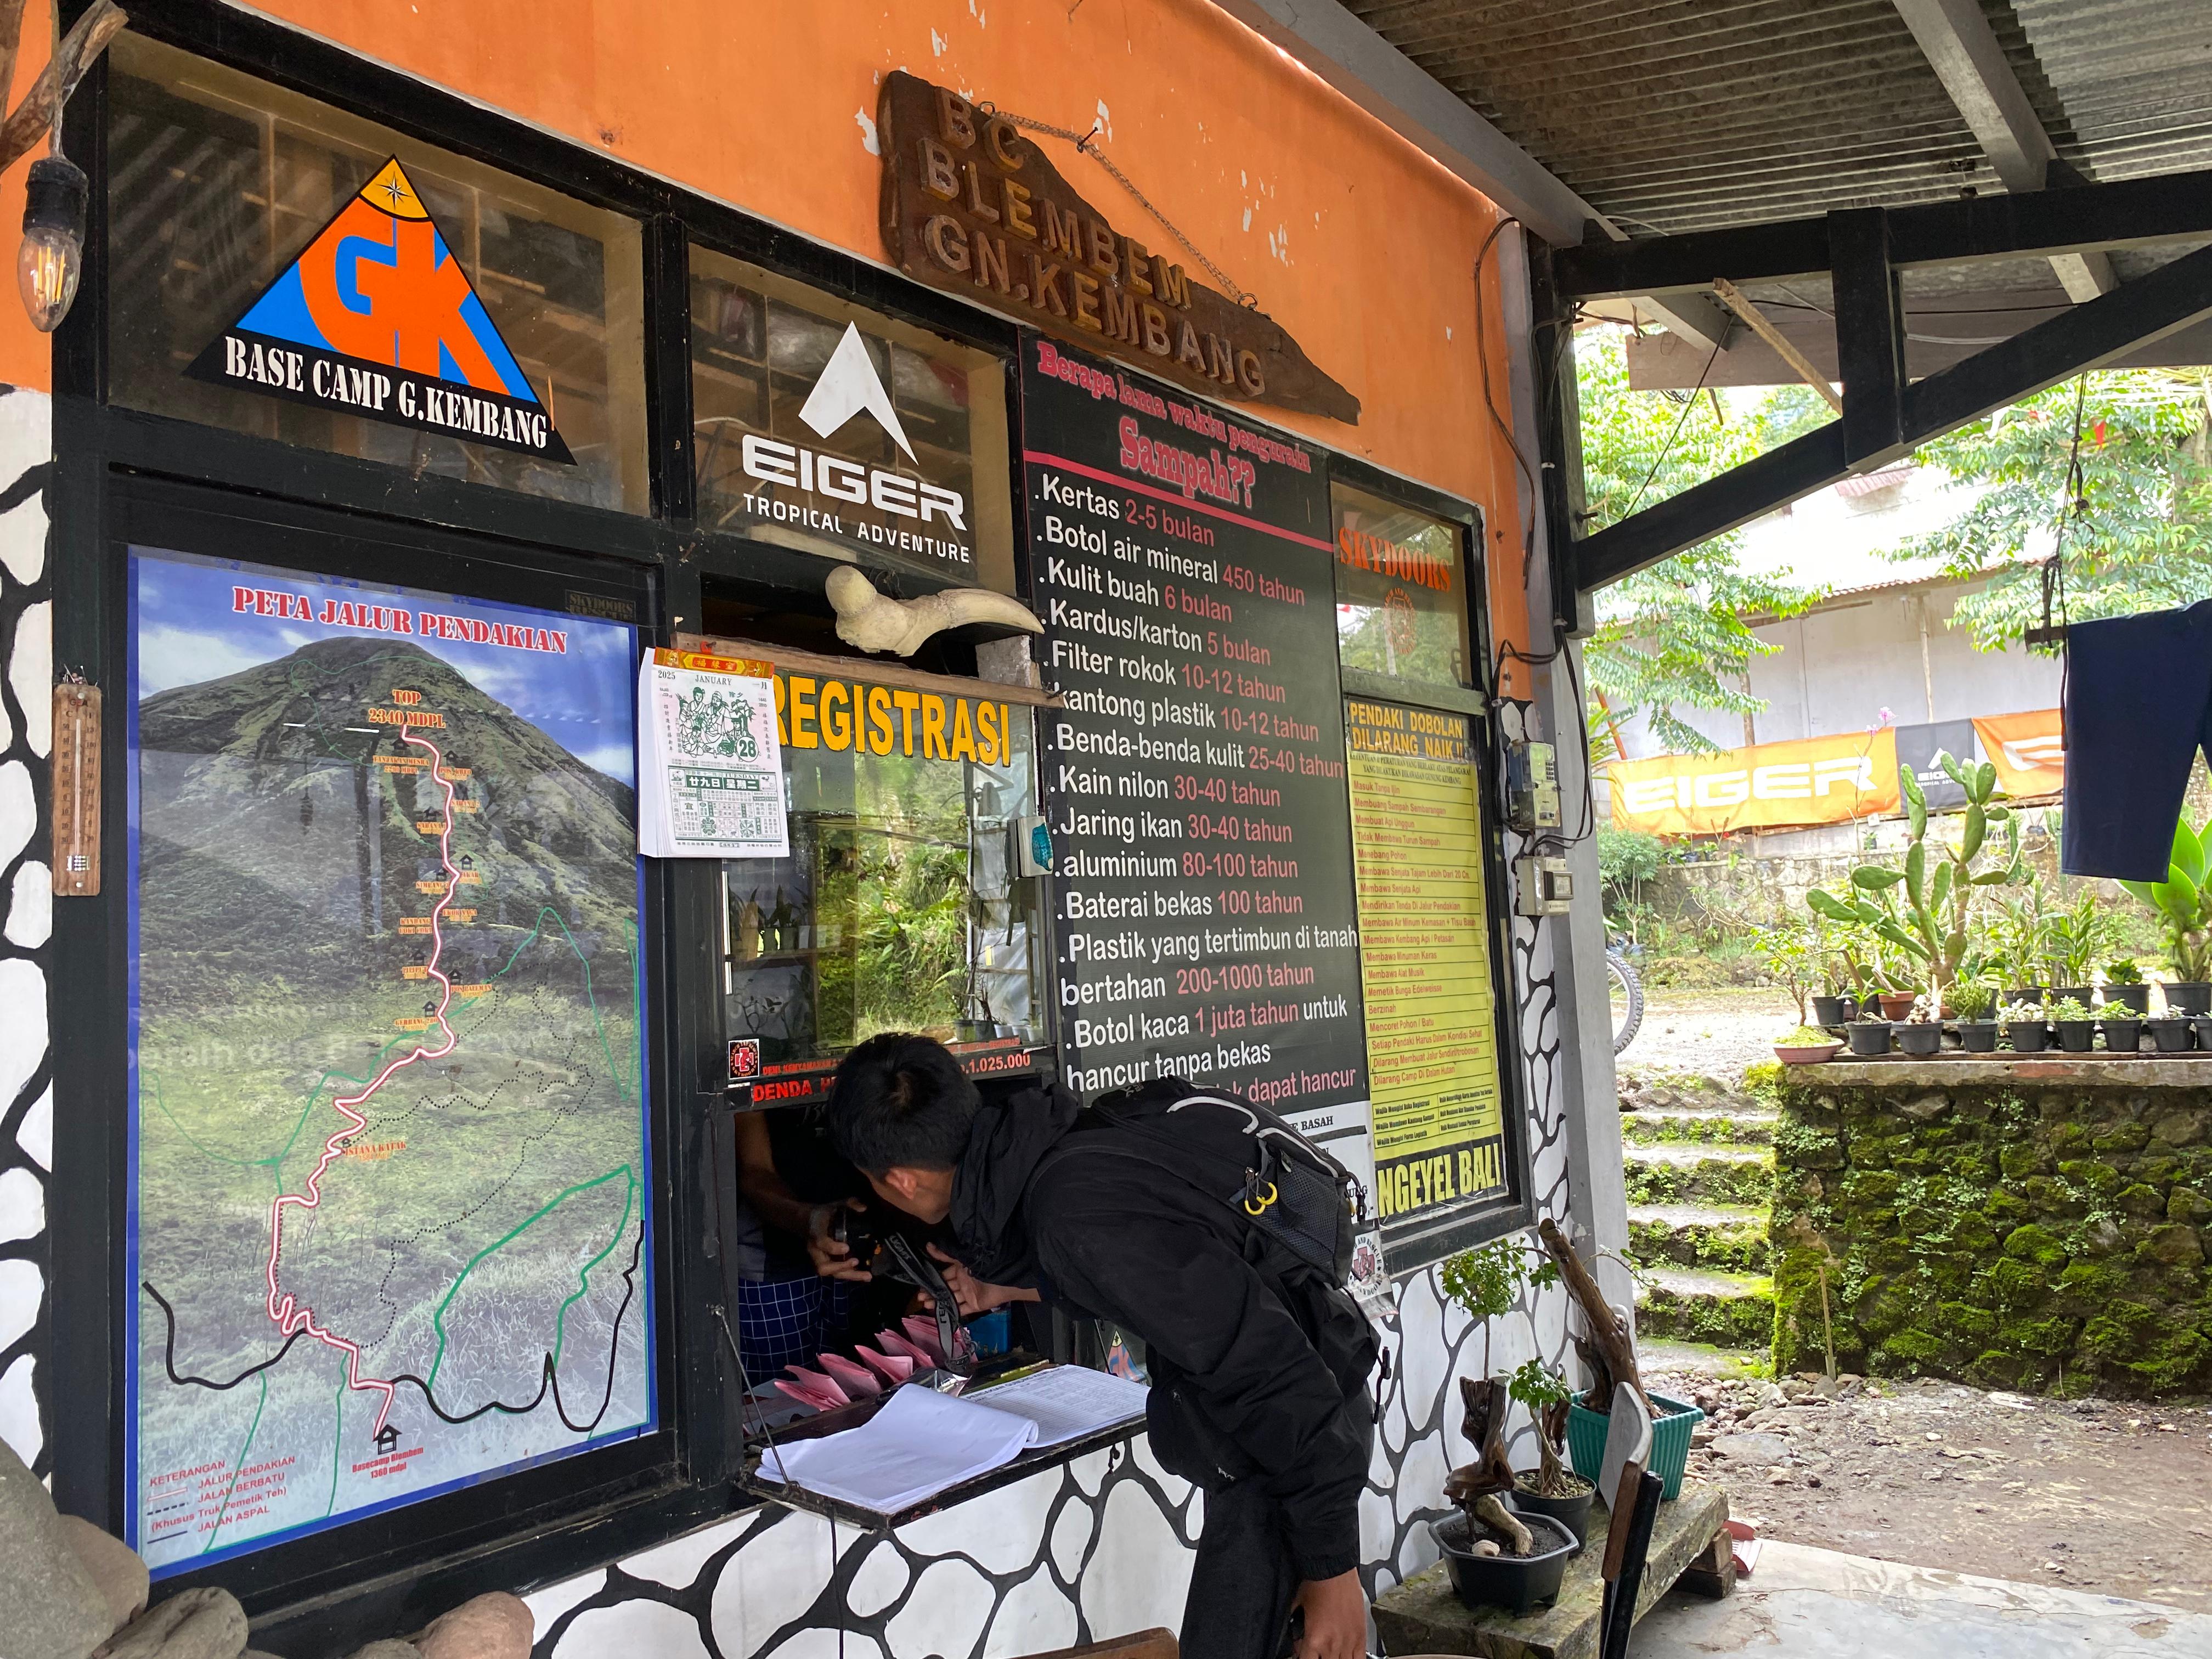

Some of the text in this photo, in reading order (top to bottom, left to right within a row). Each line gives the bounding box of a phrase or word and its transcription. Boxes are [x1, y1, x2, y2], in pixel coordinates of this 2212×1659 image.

[917, 137, 1192, 310] BLEMBEM
[924, 215, 1265, 397] GN.KEMBANG
[225, 336, 546, 449] BASE CAMP G.KEMBANG
[1037, 341, 1311, 473] Berapa lama waktu pengurain
[1120, 416, 1255, 509] Sampah??
[742, 435, 967, 531] EIGER
[743, 493, 970, 563] TROPICAL ADVENTURE
[1126, 499, 1156, 530] 2-5
[1163, 509, 1214, 546] bulan
[1114, 537, 1142, 563] air
[1147, 550, 1217, 584] mineral
[1223, 565, 1254, 592] 450
[1259, 573, 1305, 605] tahun
[1339, 527, 1451, 592] SKYDOORS
[1108, 569, 1159, 606] buah
[1165, 585, 1175, 610] 6
[1182, 588, 1232, 623] bulan
[232, 586, 312, 621] PETA
[321, 600, 411, 635] JALUR
[419, 612, 567, 654] PENDAKIAN
[1207, 631, 1217, 655] 5
[1223, 635, 1271, 666] bulan
[658, 670, 732, 686] 2025 JANUARY
[1119, 655, 1176, 685] rokok
[1182, 664, 1233, 695] 10-12
[1238, 677, 1285, 703] tahun
[393, 689, 421, 706] TOP
[369, 708, 446, 729] 2340 MDPL
[1153, 697, 1216, 728] plastik
[1221, 707, 1269, 736] 10-12
[1273, 716, 1319, 742] tahun
[1350, 702, 1463, 739] PENDAKI DOBOLAN
[739, 741, 756, 757] 28
[1206, 740, 1245, 768] kulit
[1249, 746, 1294, 772] 25-40
[1299, 753, 1343, 778] tahun
[1352, 727, 1418, 755] DILARANG
[1425, 737, 1453, 759] NAIK
[689, 777, 757, 789] 廿九日 星期二
[1119, 771, 1168, 799] nilon
[1175, 775, 1226, 803] 30-40
[1232, 782, 1280, 806] tahun
[1353, 780, 1373, 791] Masuk
[1374, 782, 1390, 795] Tanpa
[1624, 755, 1878, 814] EIGER
[1355, 798, 1387, 811] Membuang
[1387, 802, 1409, 812] Sampah
[1141, 811, 1182, 838] ikan
[1188, 815, 1239, 840] 30-40
[1244, 819, 1292, 843] tahun
[1356, 815, 1414, 829] Membuat Api Unggun
[1357, 832, 1440, 847] Tidak Membawa Turun Sampah
[1358, 849, 1407, 860] Menebang Pohon
[1183, 852, 1245, 877] 80-100
[1250, 854, 1298, 878] tahun
[1154, 890, 1212, 917] bekas
[1218, 890, 1250, 915] 100
[1255, 889, 1303, 913] tahun
[1361, 883, 1421, 895] Membawa Senjata Api
[1152, 935, 1199, 964] yang
[1205, 927, 1290, 953] tertimbun
[1295, 925, 1310, 949] di
[1314, 924, 1358, 949] tanah
[1367, 952, 1396, 961] Membawa
[1421, 951, 1437, 960] Keras
[1060, 963, 1314, 1006] bertahan 200-1000 tahun
[1141, 1012, 1189, 1040] kaca
[1195, 1007, 1204, 1032] 1
[1210, 1006, 1245, 1038] juta
[1251, 999, 1299, 1025] tahun
[1303, 994, 1348, 1020] untuk
[1369, 1005, 1396, 1014] Berzinah
[1370, 1020, 1398, 1032] Mencoret
[1400, 1020, 1417, 1029] Pohon
[1372, 1039, 1391, 1049] Setiap
[1393, 1037, 1414, 1047] Pendaki
[1416, 1035, 1432, 1045] Harus
[1432, 1034, 1447, 1042] Dalam
[1448, 1032, 1468, 1040] Kondisi
[763, 1065, 781, 1075] DEMI
[1068, 1041, 1272, 1093] hancur tanpa bekas
[1374, 1066, 1455, 1085] Dilarang Camp Di Dalam Hutan
[753, 1080, 812, 1102] DENDA
[1248, 1071, 1297, 1106] dapat
[1301, 1068, 1357, 1094] hancur
[1301, 1116, 1333, 1131] BASAH
[1378, 1143, 1501, 1217] NGEYEL BALI
[1367, 1239, 1382, 1263] RESCUE
[150, 1460, 225, 1487] KETERANGAN
[198, 1456, 296, 1489] JALUR PENDAKIAN
[352, 1457, 390, 1473] Basecamp
[371, 1462, 407, 1479] 1360 mdpl
[198, 1472, 285, 1503] JALAN BERBATU
[151, 1486, 287, 1533] (Khusus Truk Pemetik Teh)
[198, 1506, 270, 1532] JALAN ASPAL
